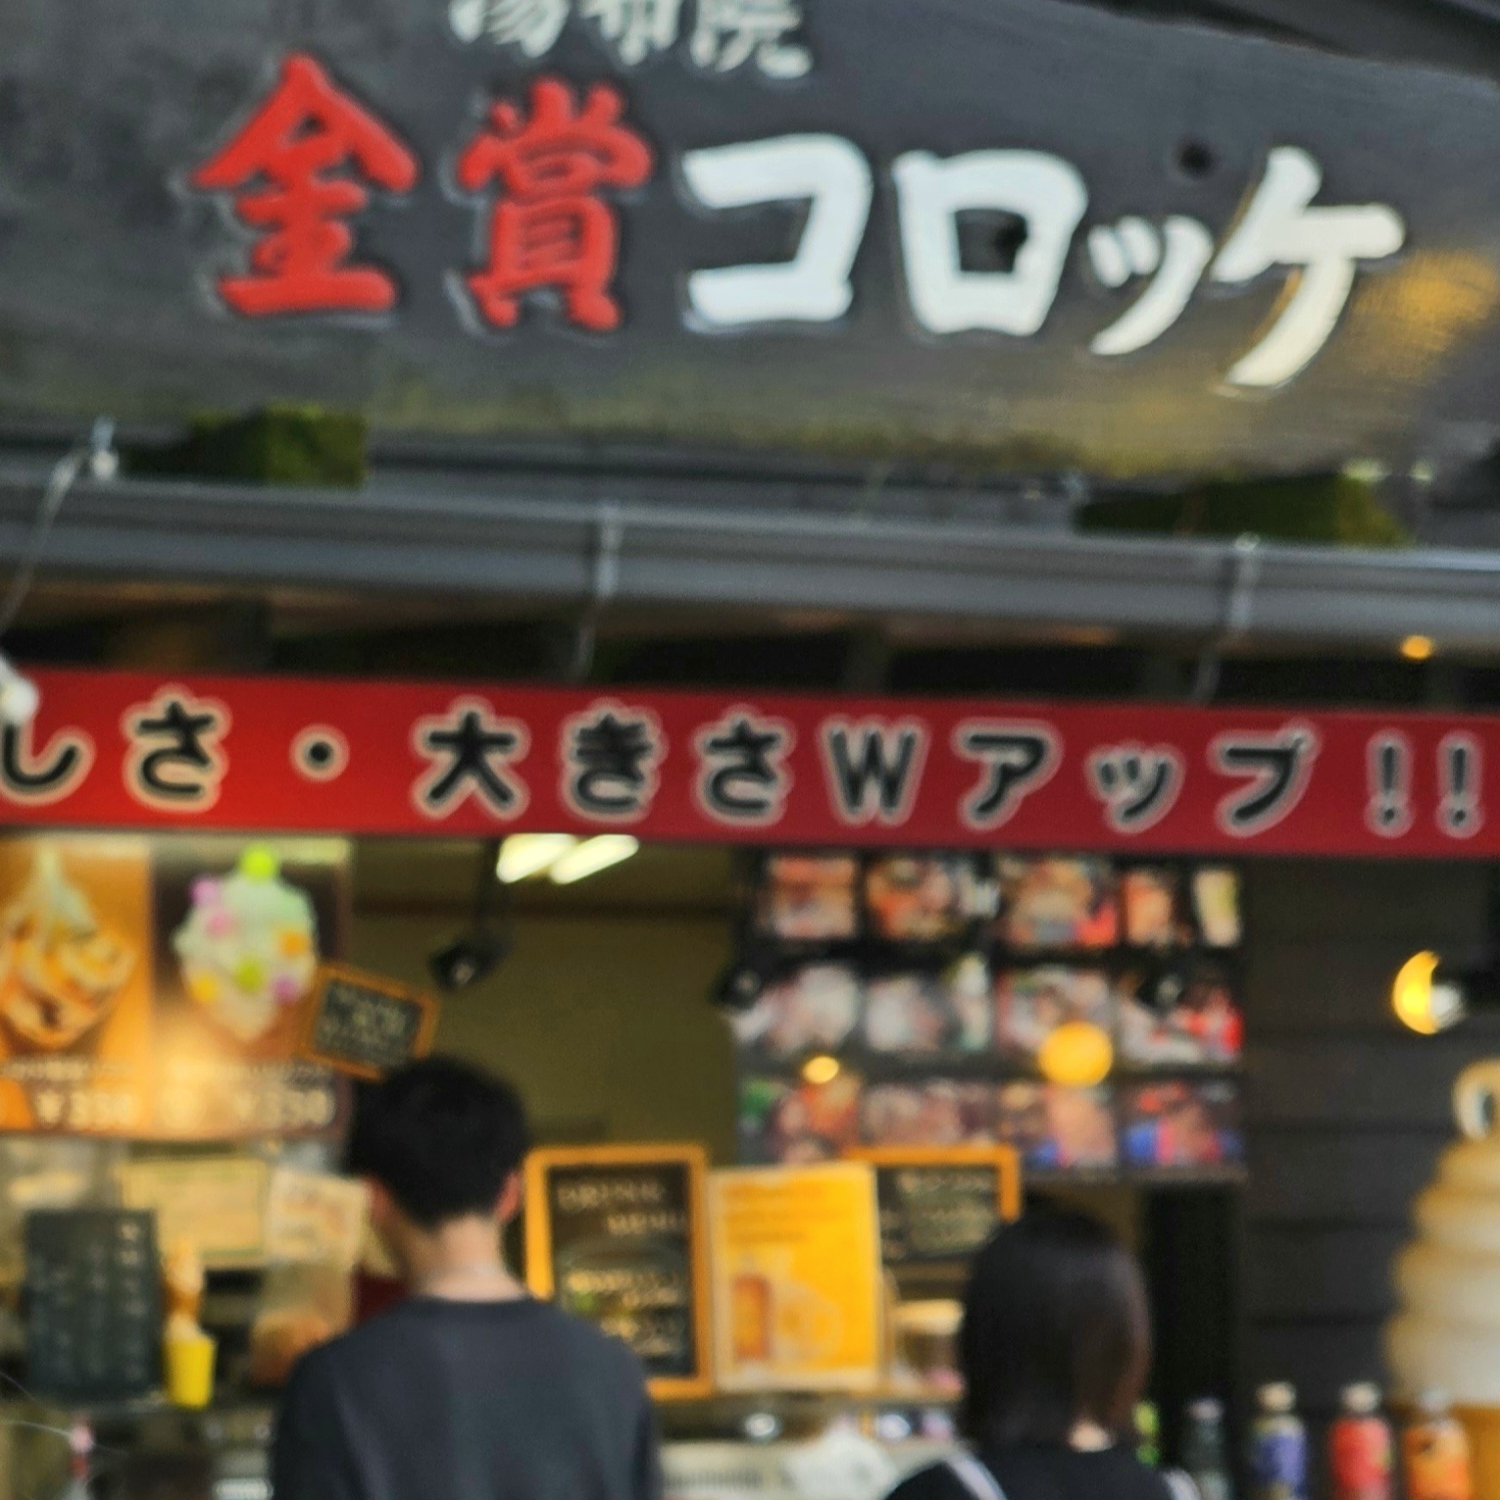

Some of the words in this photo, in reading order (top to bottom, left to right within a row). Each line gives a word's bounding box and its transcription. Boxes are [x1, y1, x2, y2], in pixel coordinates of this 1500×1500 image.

[190, 54, 1406, 390] 金賞コロッケ
